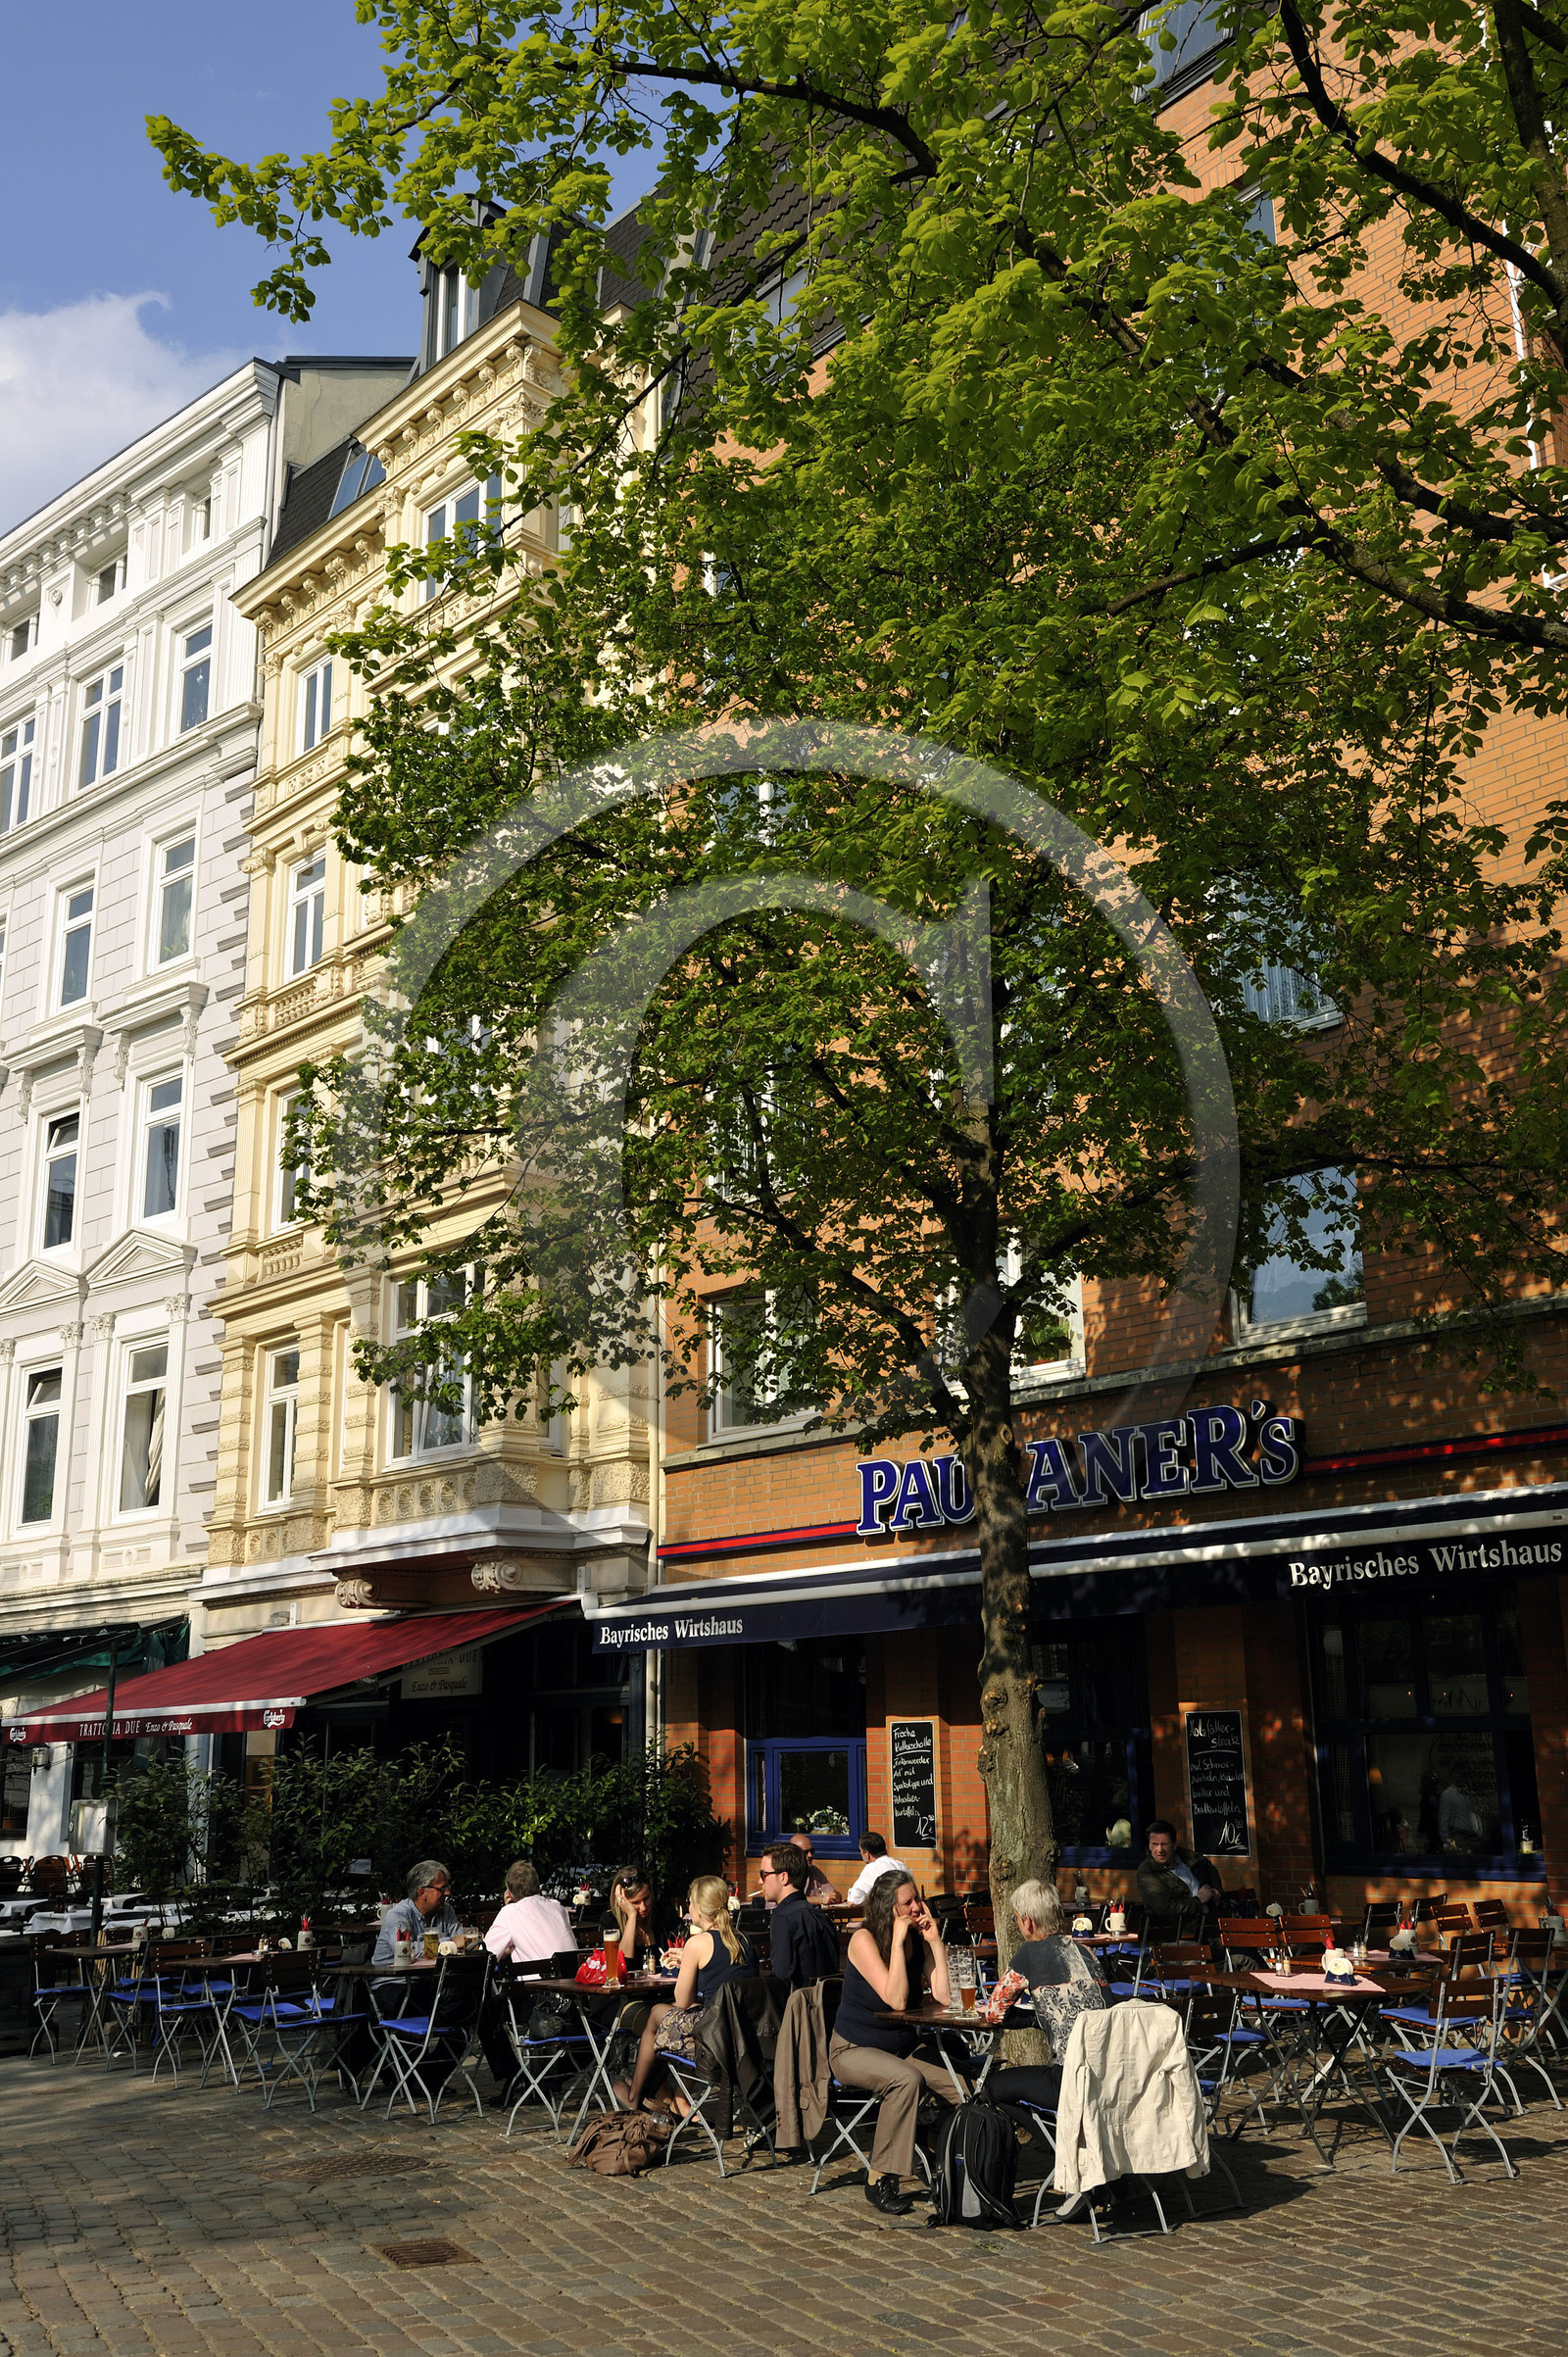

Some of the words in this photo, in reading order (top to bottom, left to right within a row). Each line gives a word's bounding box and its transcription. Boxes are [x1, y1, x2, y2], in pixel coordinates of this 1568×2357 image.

[1289, 1552, 1420, 1590] Bayrisches
[1428, 1540, 1562, 1572] Wirtshaus
[600, 1621, 668, 1648] Bayrisches
[674, 1616, 743, 1639] Wirtshaus
[79, 1721, 121, 1737] TRATTOIA
[124, 1720, 141, 1734] DUE
[145, 1721, 161, 1733] Enzo
[168, 1717, 193, 1736] Pasquale
[264, 1709, 286, 1728] Carlsberg
[921, 1773, 934, 1786] und
